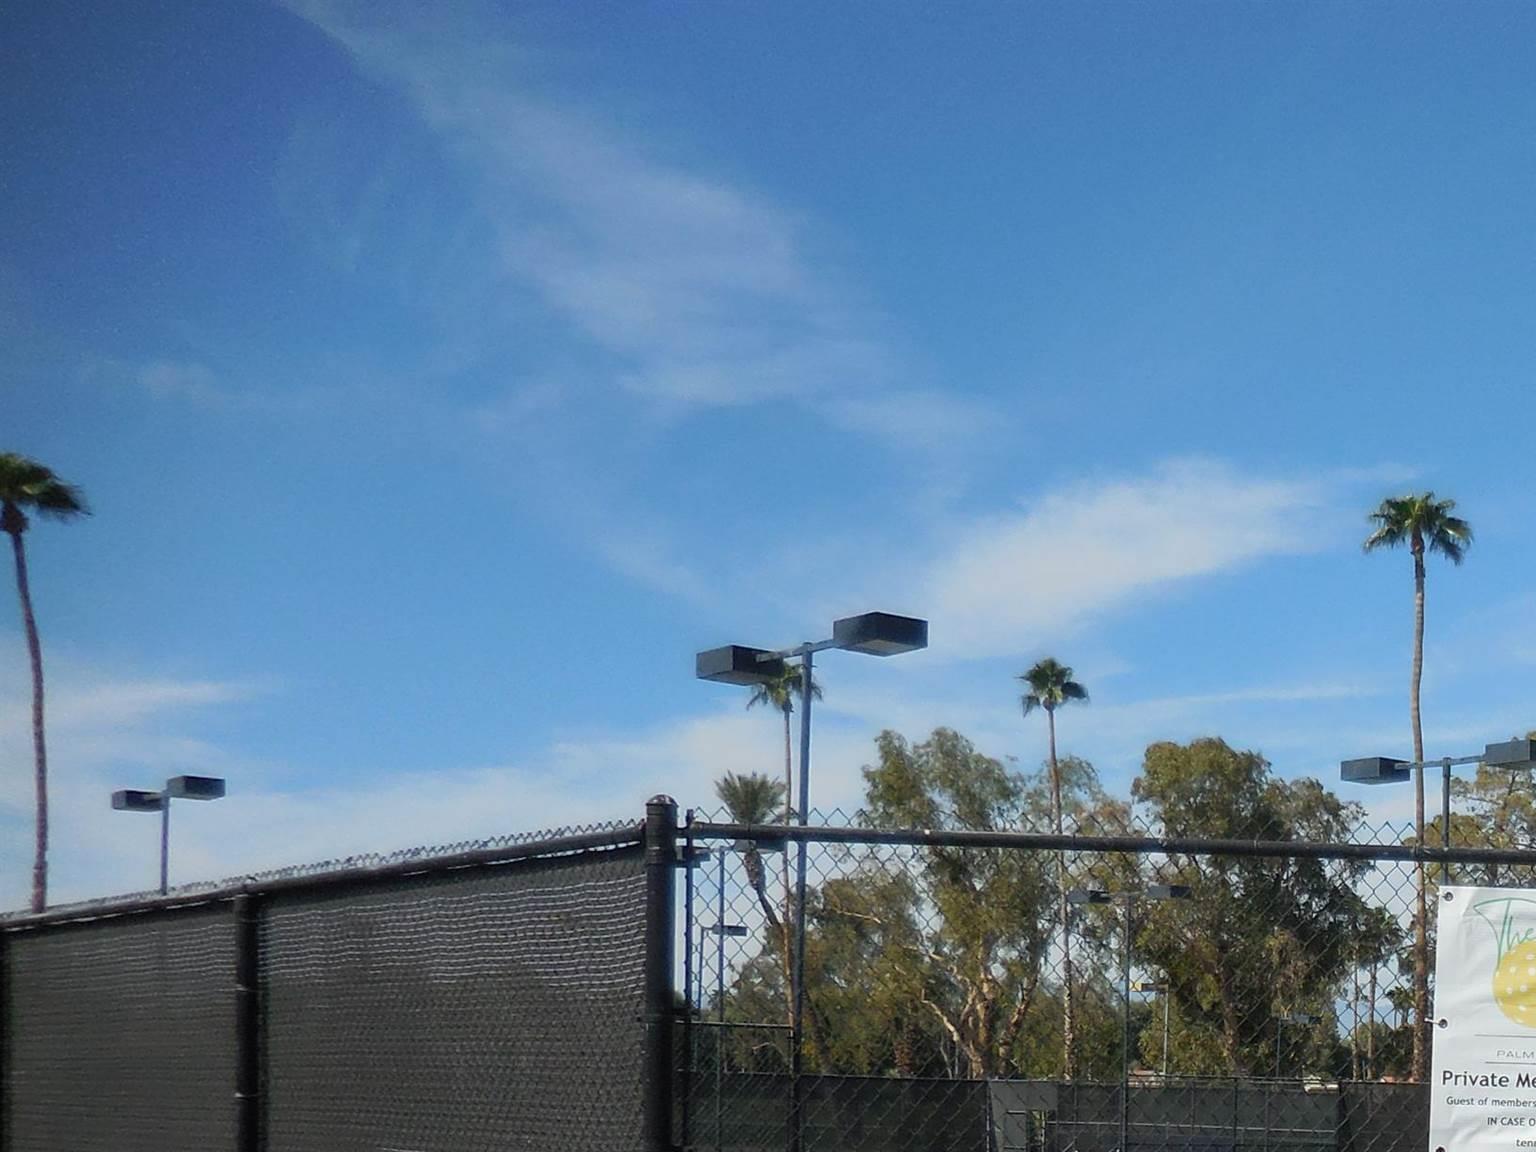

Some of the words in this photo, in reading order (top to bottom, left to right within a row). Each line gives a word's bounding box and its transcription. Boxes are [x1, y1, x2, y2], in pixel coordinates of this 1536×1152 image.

[1496, 1050, 1535, 1060] PALM
[1442, 1070, 1510, 1087] Private
[1446, 1095, 1475, 1106] Guest
[1479, 1096, 1489, 1106] of
[1487, 1116, 1498, 1126] IN
[1500, 1117, 1525, 1127] CASE
